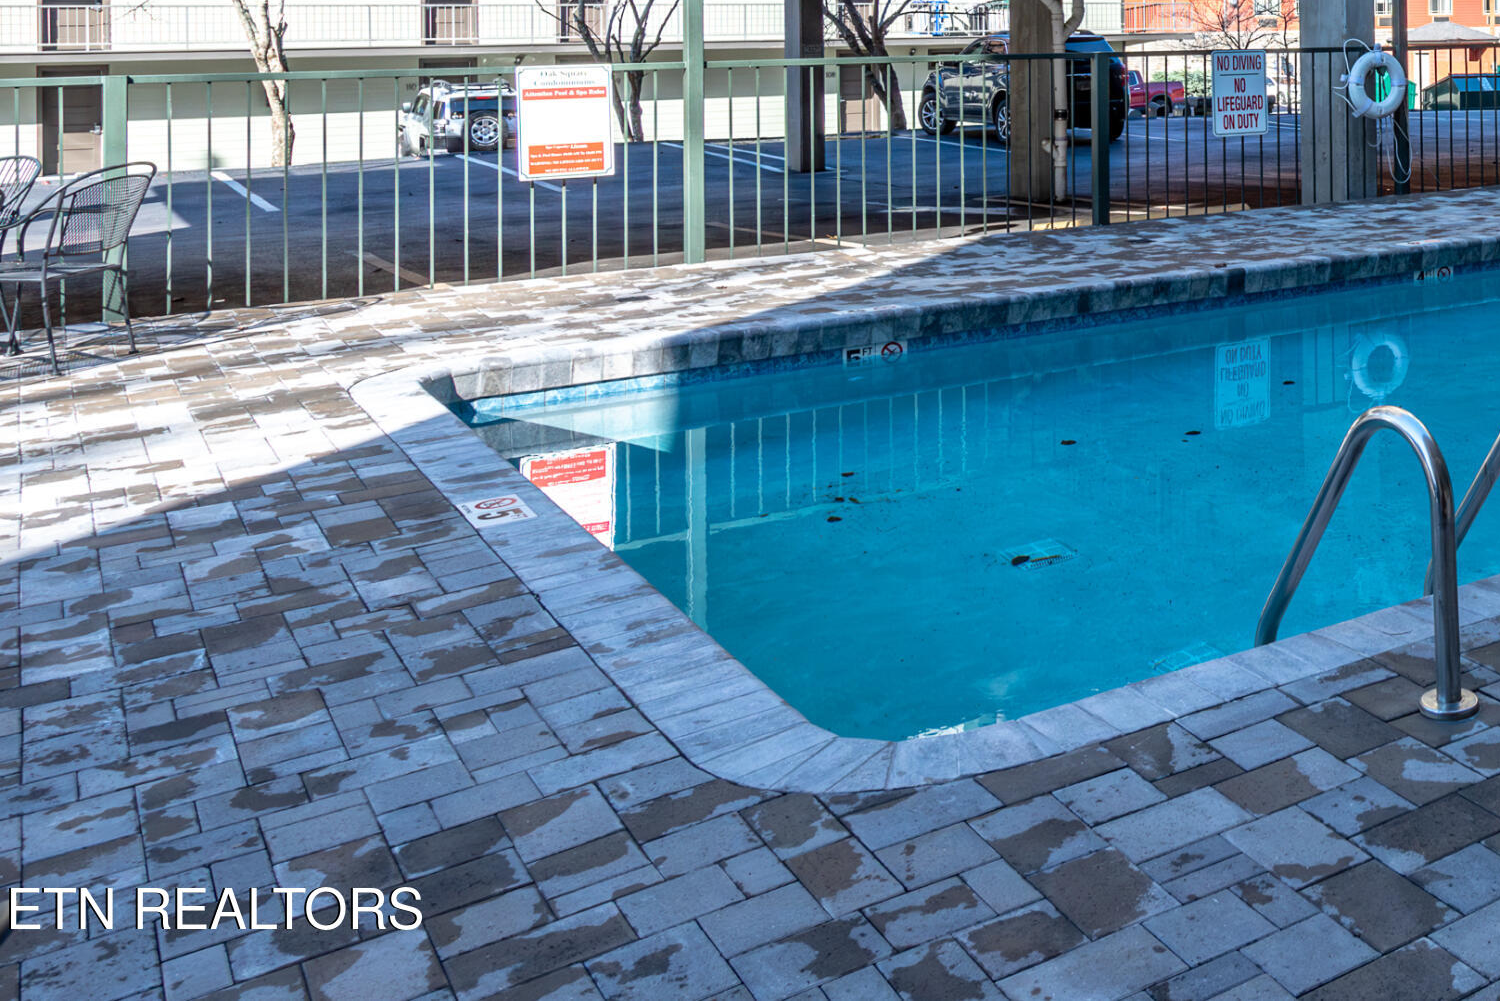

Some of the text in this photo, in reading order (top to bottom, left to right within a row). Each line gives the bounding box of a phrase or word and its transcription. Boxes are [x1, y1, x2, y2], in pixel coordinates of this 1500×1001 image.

[1216, 54, 1262, 71] NO DIVING
[1234, 77, 1247, 94] NO
[1217, 94, 1264, 112] LIFEGUARD
[1223, 112, 1259, 130] ON DUTY
[862, 347, 873, 357] FT
[477, 507, 523, 520] 5
